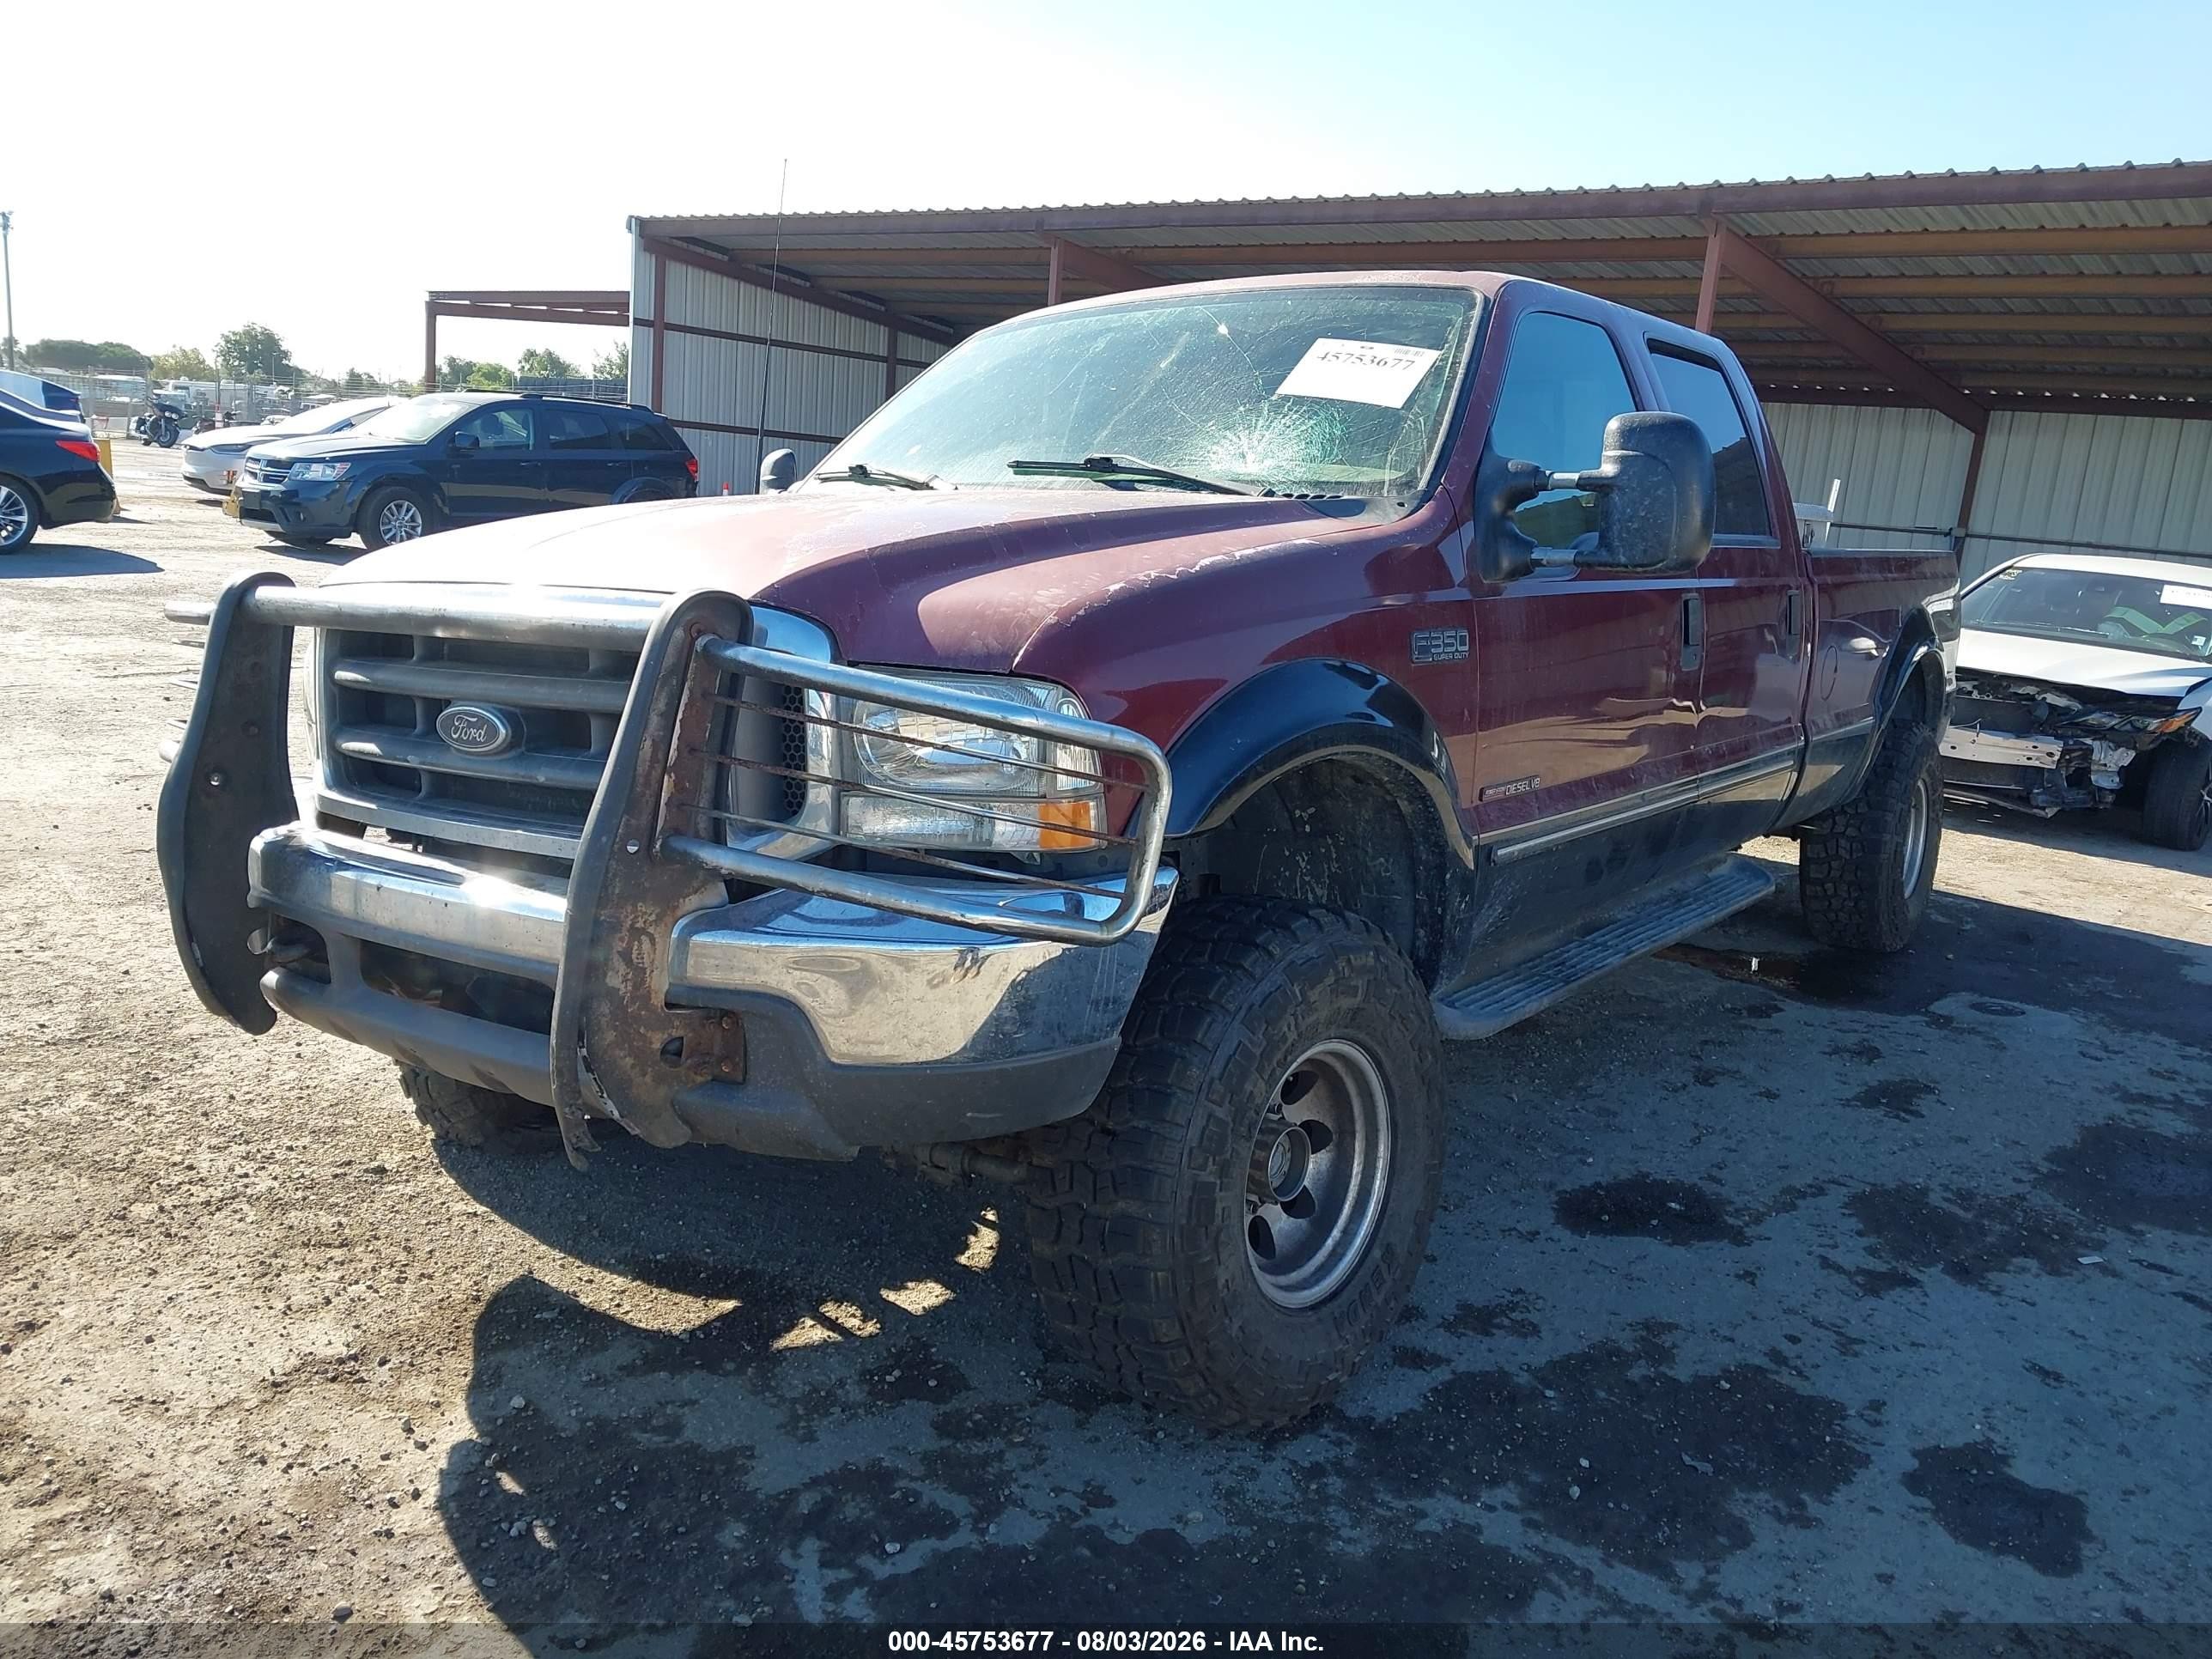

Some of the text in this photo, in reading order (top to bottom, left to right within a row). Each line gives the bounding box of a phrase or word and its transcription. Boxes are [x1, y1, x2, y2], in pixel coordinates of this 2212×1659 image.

[1316, 350, 1416, 371] 45753677
[1432, 651, 1469, 661] SUPER DUTY
[451, 714, 488, 743] Ford
[1505, 780, 1531, 796] DIESEL
[1531, 776, 1540, 789] V8
